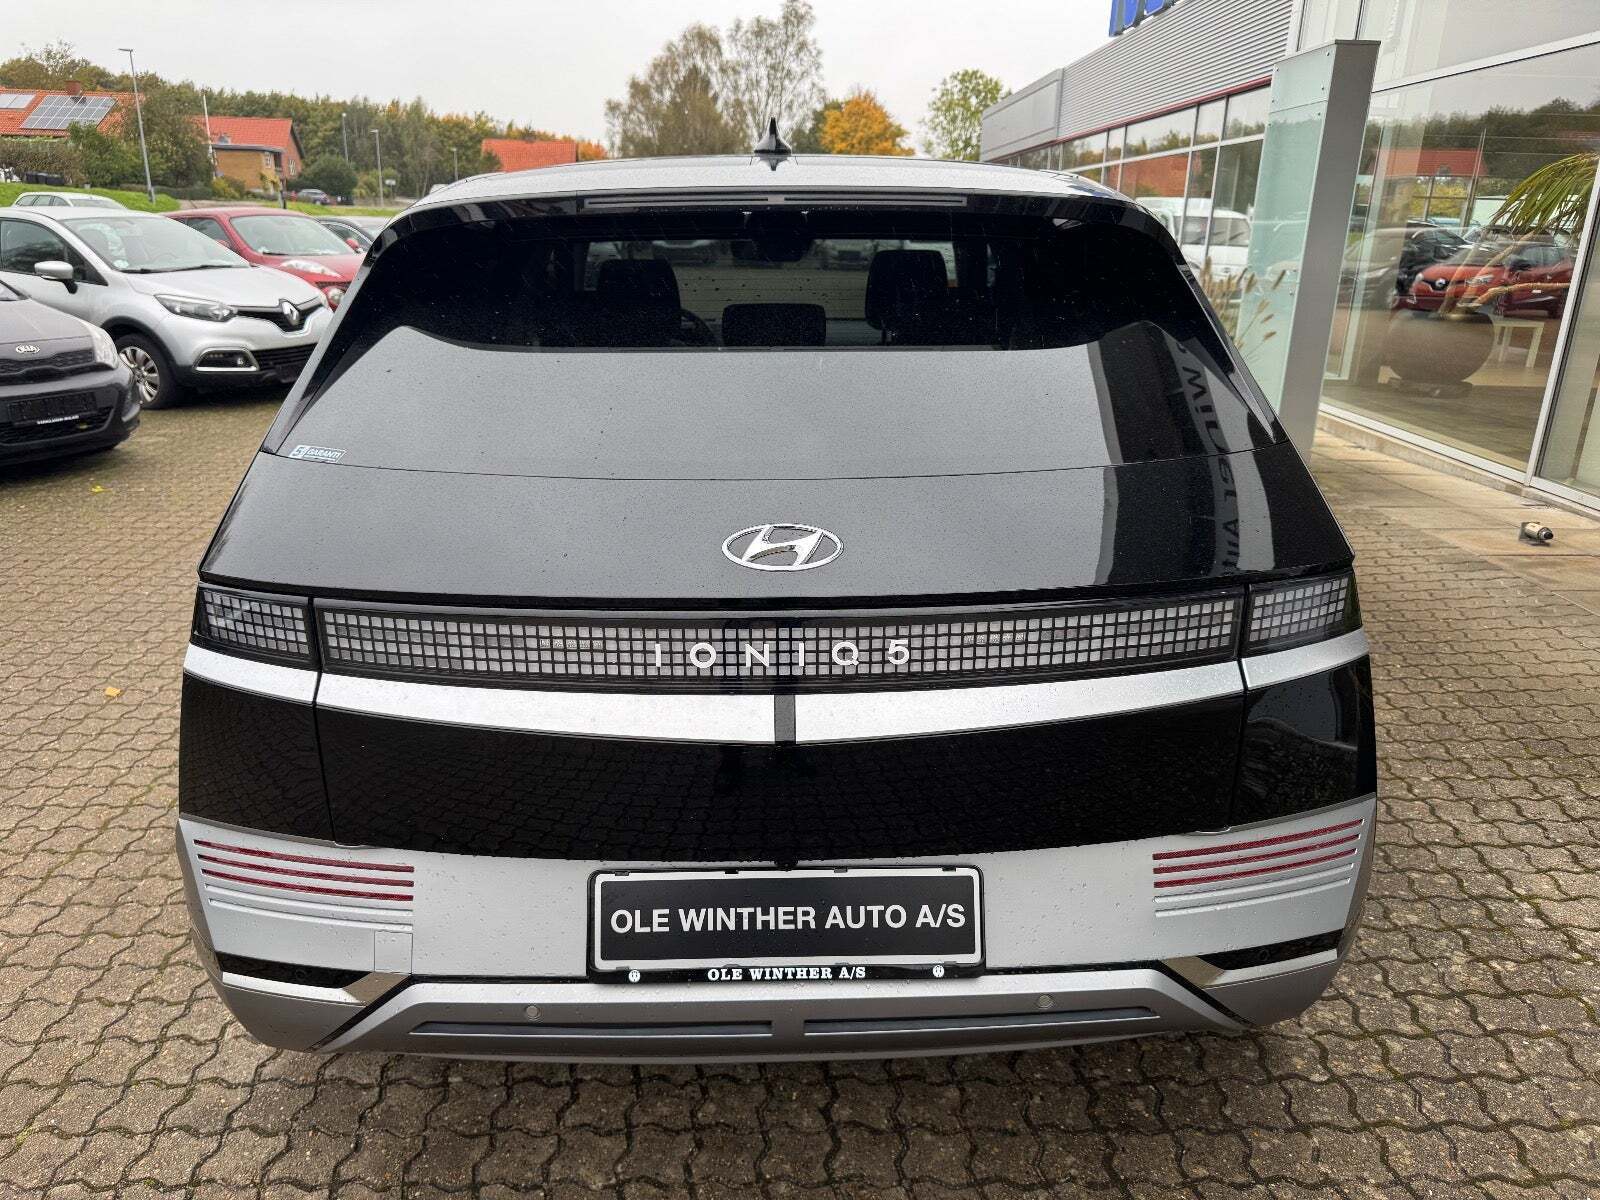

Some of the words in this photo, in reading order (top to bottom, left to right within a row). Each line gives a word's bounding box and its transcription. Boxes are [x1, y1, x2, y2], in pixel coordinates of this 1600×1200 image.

[654, 641, 860, 669] IONIQ
[887, 639, 910, 665] 5
[610, 908, 670, 934] OLE
[678, 906, 816, 932] WINTHER
[824, 904, 907, 929] AUTO
[915, 903, 966, 928] A/S
[707, 968, 742, 981] OLE
[750, 967, 832, 981] WINTHER
[838, 966, 866, 980] A/S
